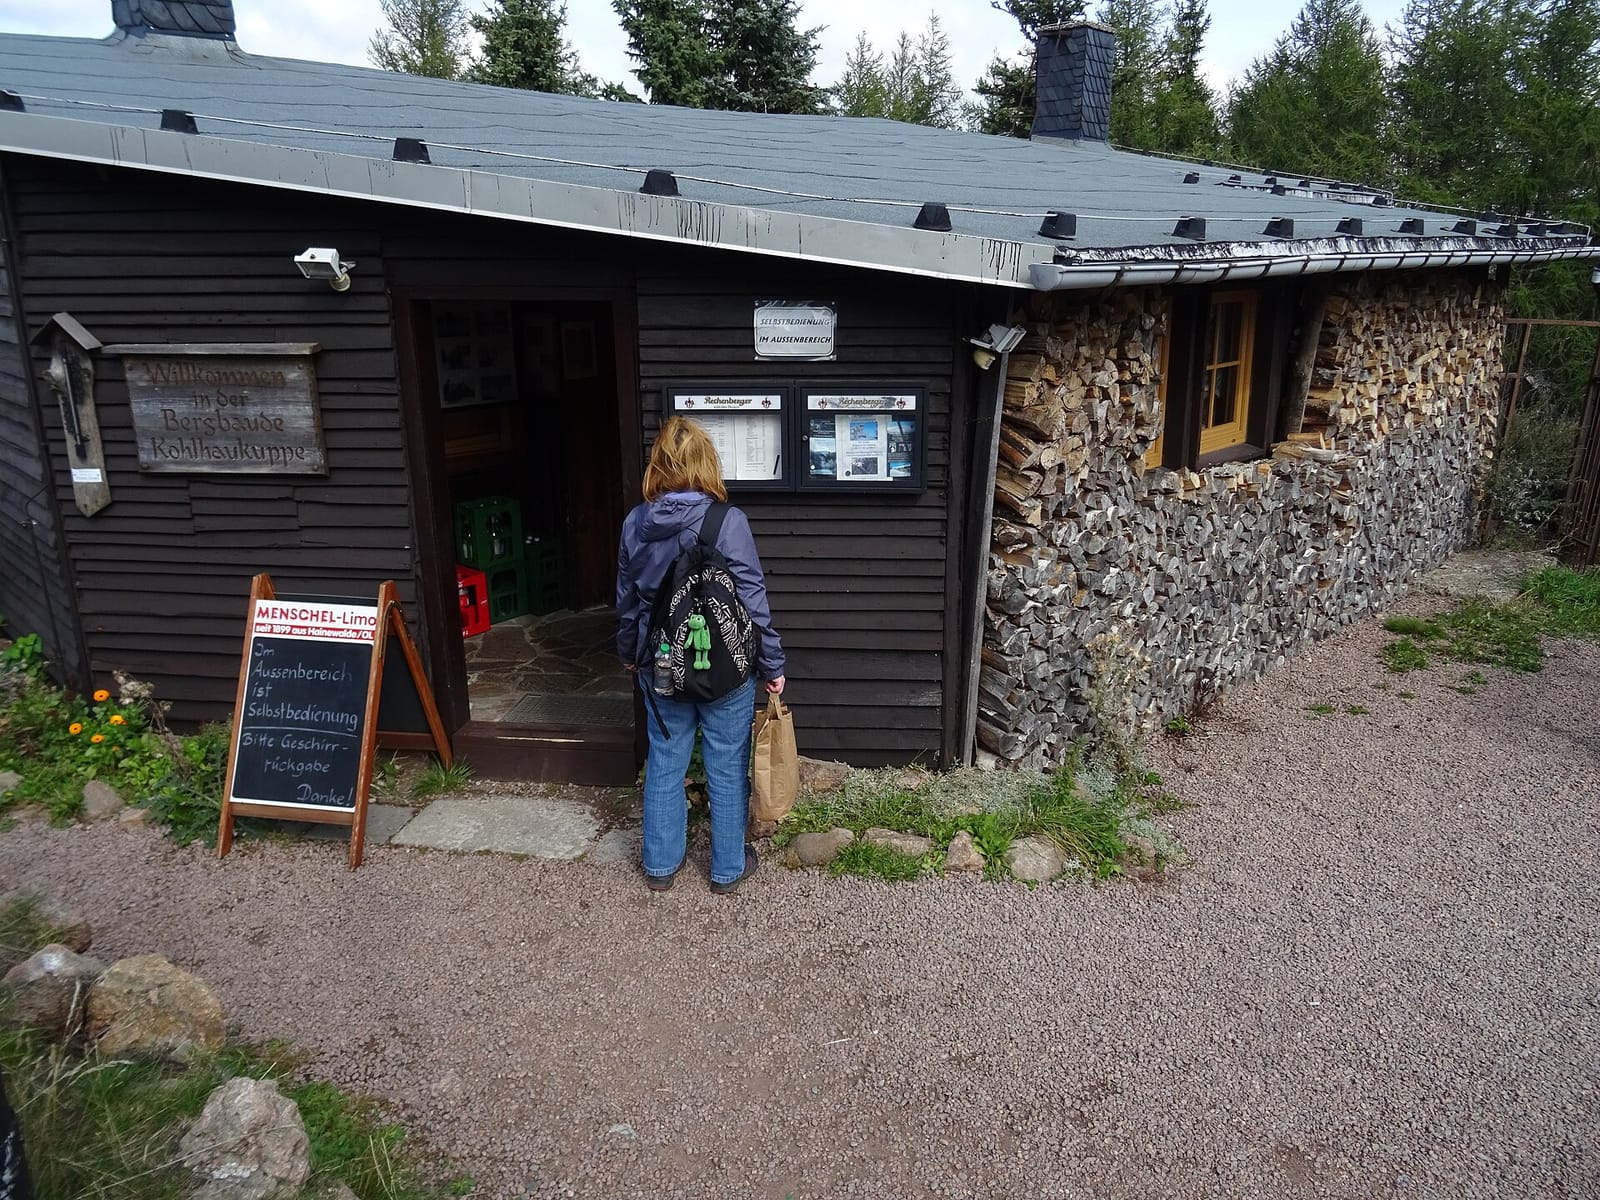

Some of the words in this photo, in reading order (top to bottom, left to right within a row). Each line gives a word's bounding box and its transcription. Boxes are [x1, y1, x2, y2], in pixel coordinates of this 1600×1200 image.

[760, 318, 830, 326] SELBSTBEDIENUNG
[144, 362, 286, 386] Willkommen
[193, 392, 210, 408] in
[216, 388, 248, 408] der
[160, 408, 285, 437] Bergbaude
[151, 437, 306, 467] Kohlhaukuppe
[256, 606, 377, 627] MENSCHEL-Limo
[255, 624, 272, 633] seit
[272, 624, 291, 635] 1899
[291, 627, 307, 636] aus
[251, 660, 353, 681] Aussenbereich
[251, 681, 273, 698] ist
[248, 702, 359, 732] Selbstbedienung
[242, 732, 275, 748] Bitte
[264, 755, 331, 778] rückgabe
[296, 783, 354, 806] Danke!
